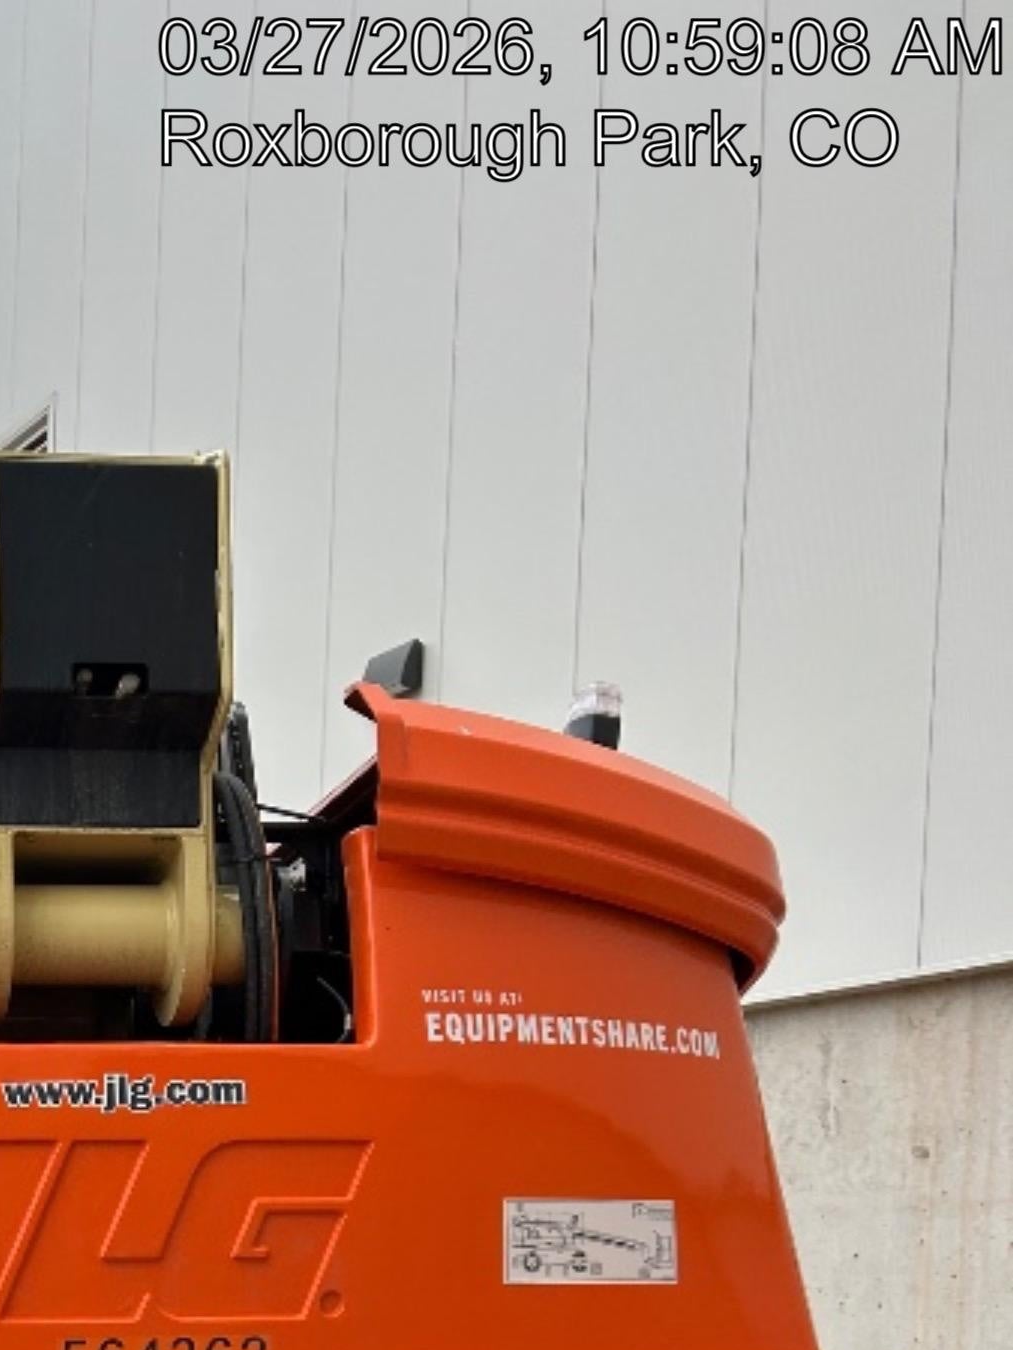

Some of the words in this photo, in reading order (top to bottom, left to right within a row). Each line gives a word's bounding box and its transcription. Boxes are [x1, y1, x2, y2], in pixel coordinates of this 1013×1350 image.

[422, 989, 466, 1003] VISIT
[425, 1011, 721, 1060] EQUIPMENTSHARE.COM
[1, 1073, 248, 1113] www.jlg.com
